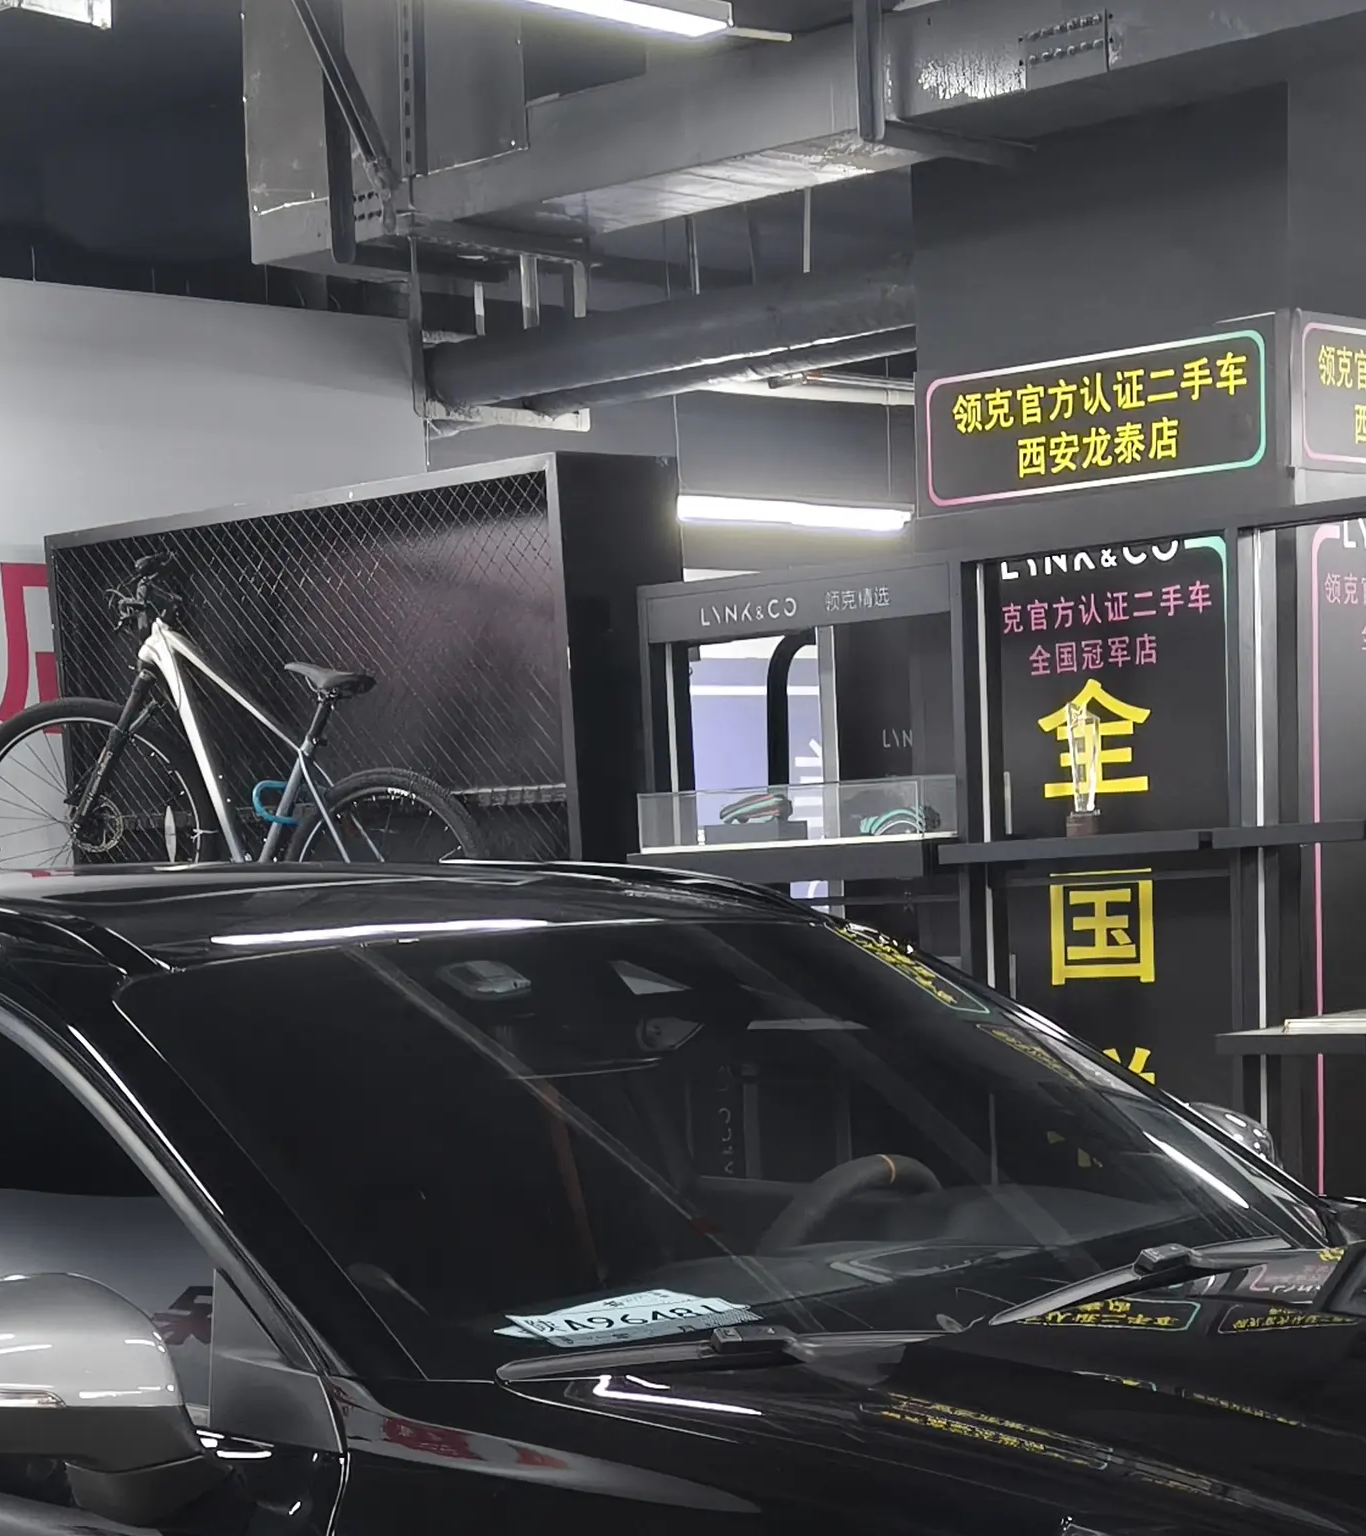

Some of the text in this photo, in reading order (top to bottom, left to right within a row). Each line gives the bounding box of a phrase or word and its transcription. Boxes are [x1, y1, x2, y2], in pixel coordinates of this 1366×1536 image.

[952, 352, 1248, 434] 领克官方认证二手车
[1017, 417, 1179, 479] 西安龙泰店
[1030, 634, 1157, 676] 全国冠军店
